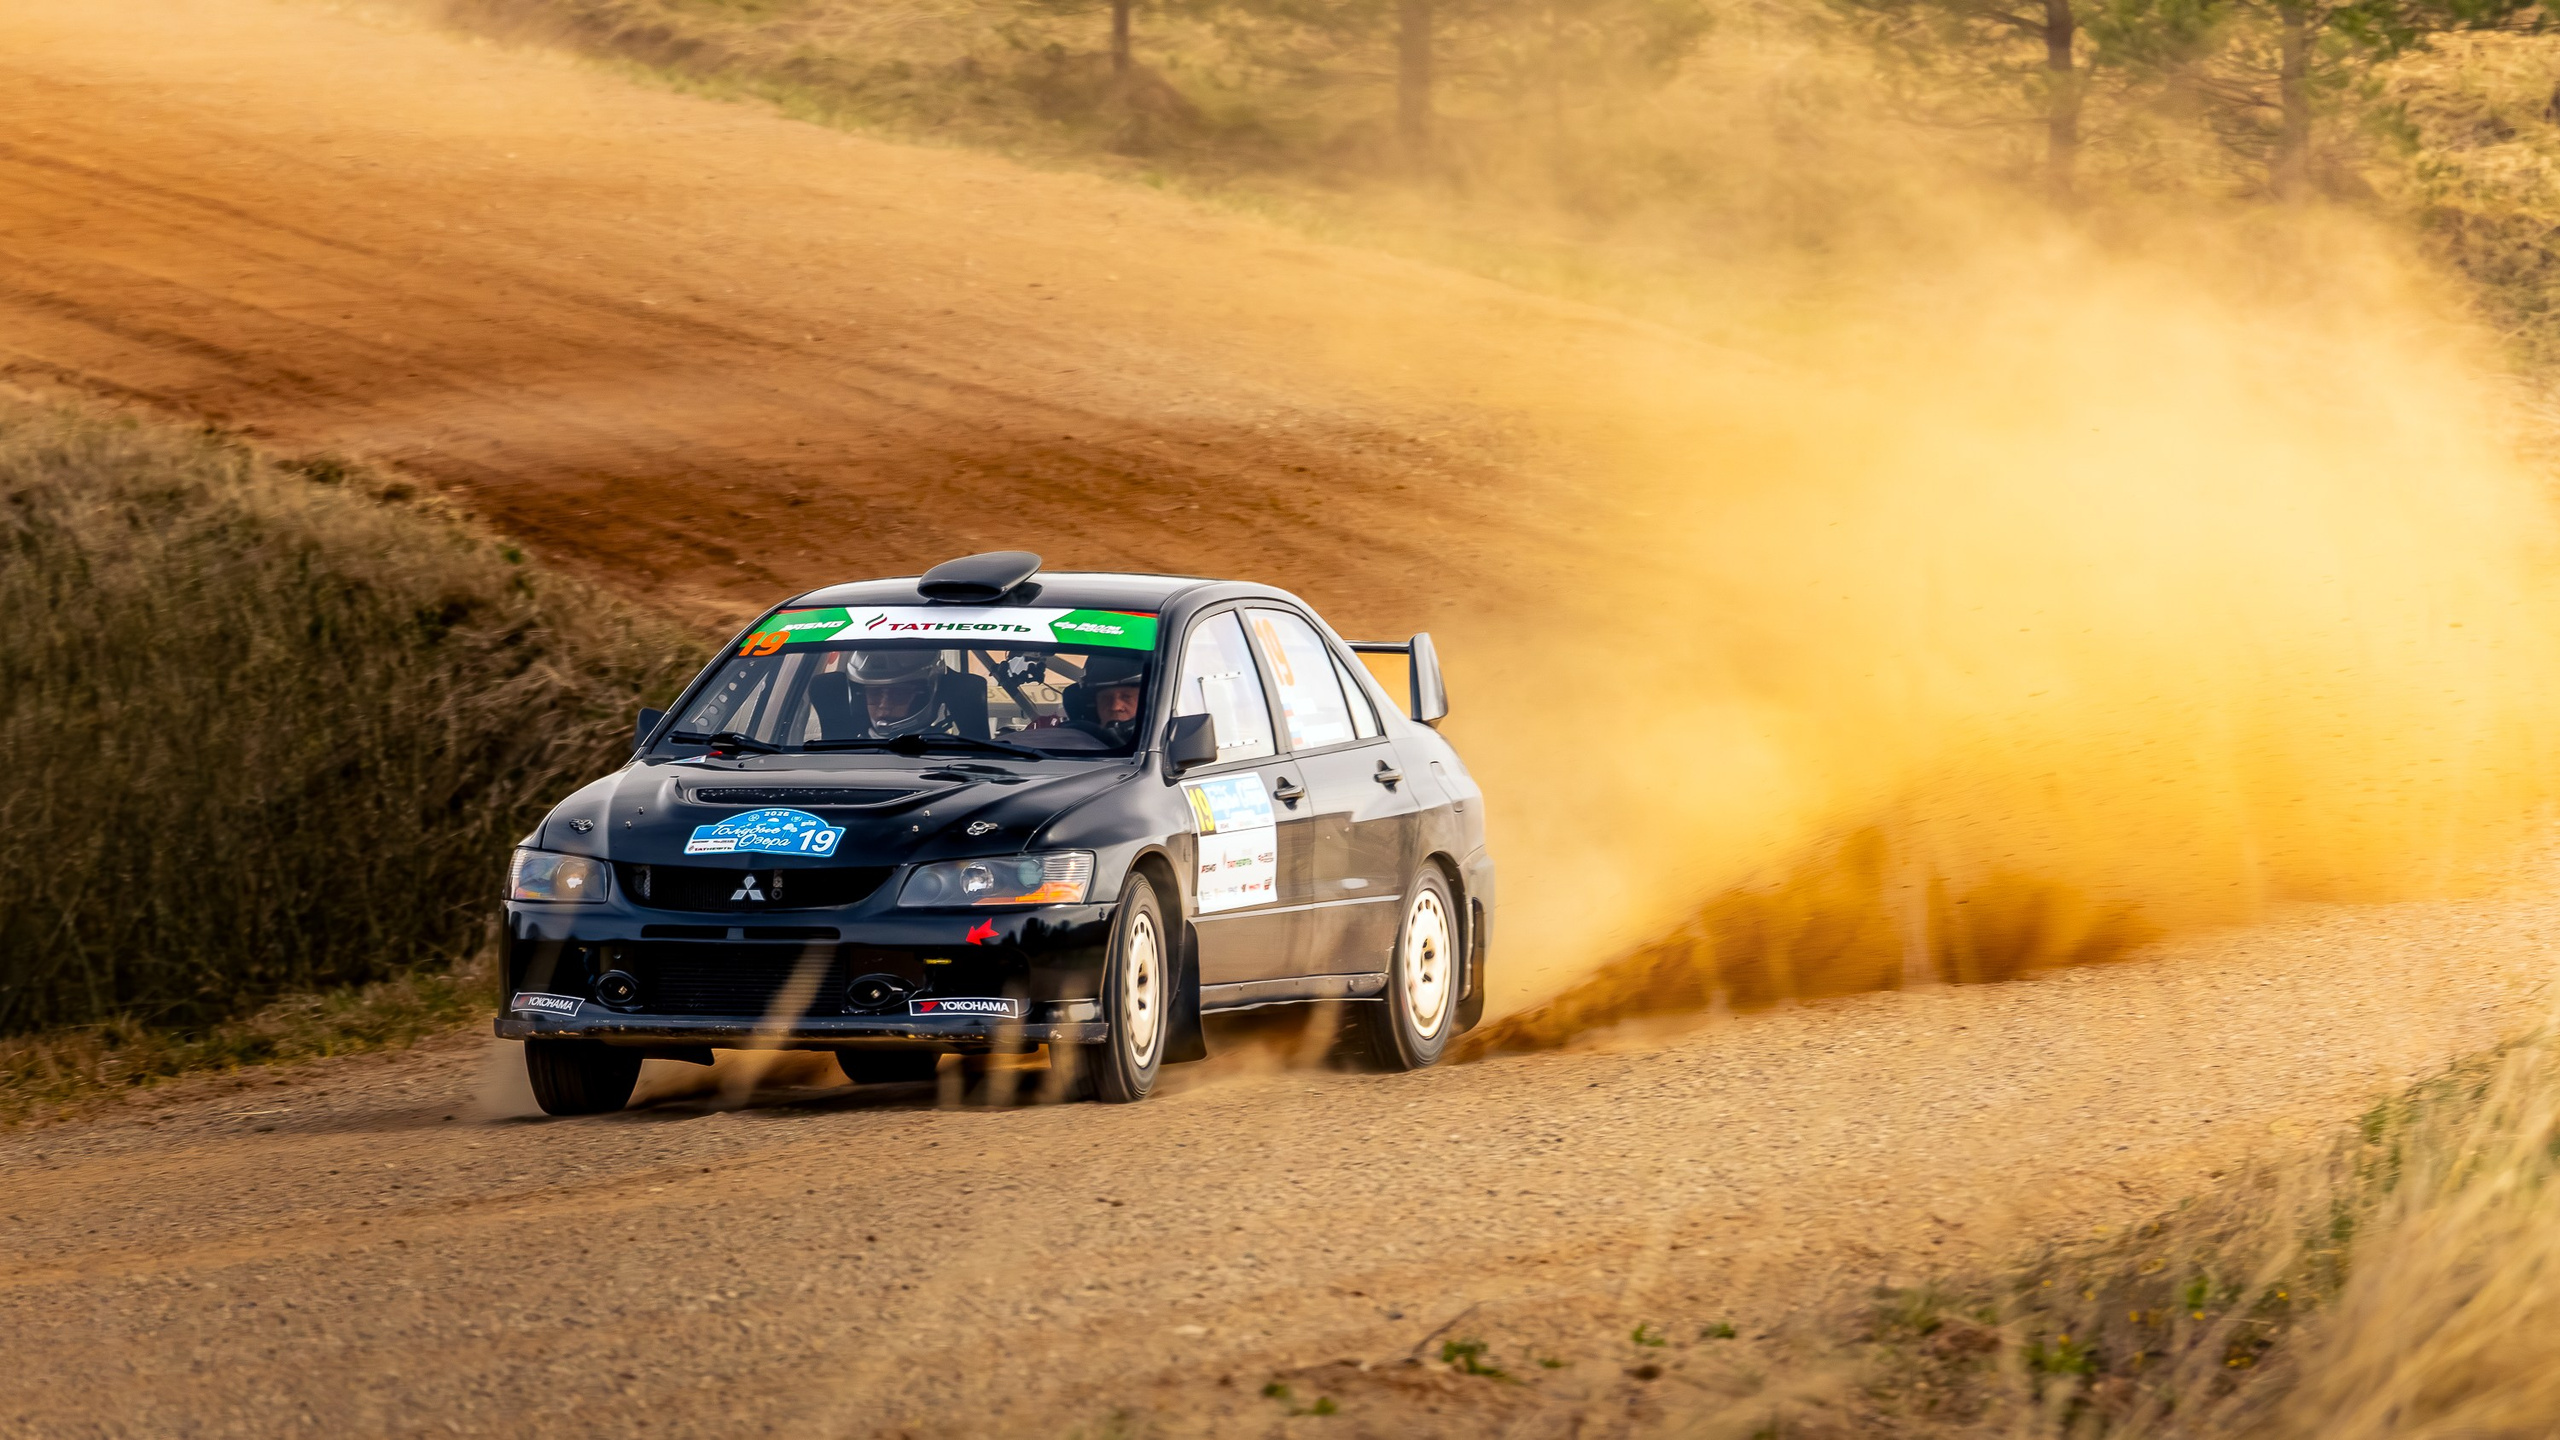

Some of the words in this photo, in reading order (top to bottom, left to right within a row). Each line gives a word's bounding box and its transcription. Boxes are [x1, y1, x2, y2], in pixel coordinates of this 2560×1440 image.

[888, 623, 1032, 633] ТАТНЕФТЬ
[739, 631, 790, 657] 19
[1254, 618, 1295, 686] 19
[1188, 787, 1215, 832] 19
[799, 829, 837, 853] 19
[527, 996, 574, 1011] YOKOHAMA
[940, 1001, 1010, 1013] YOKOHAMA
